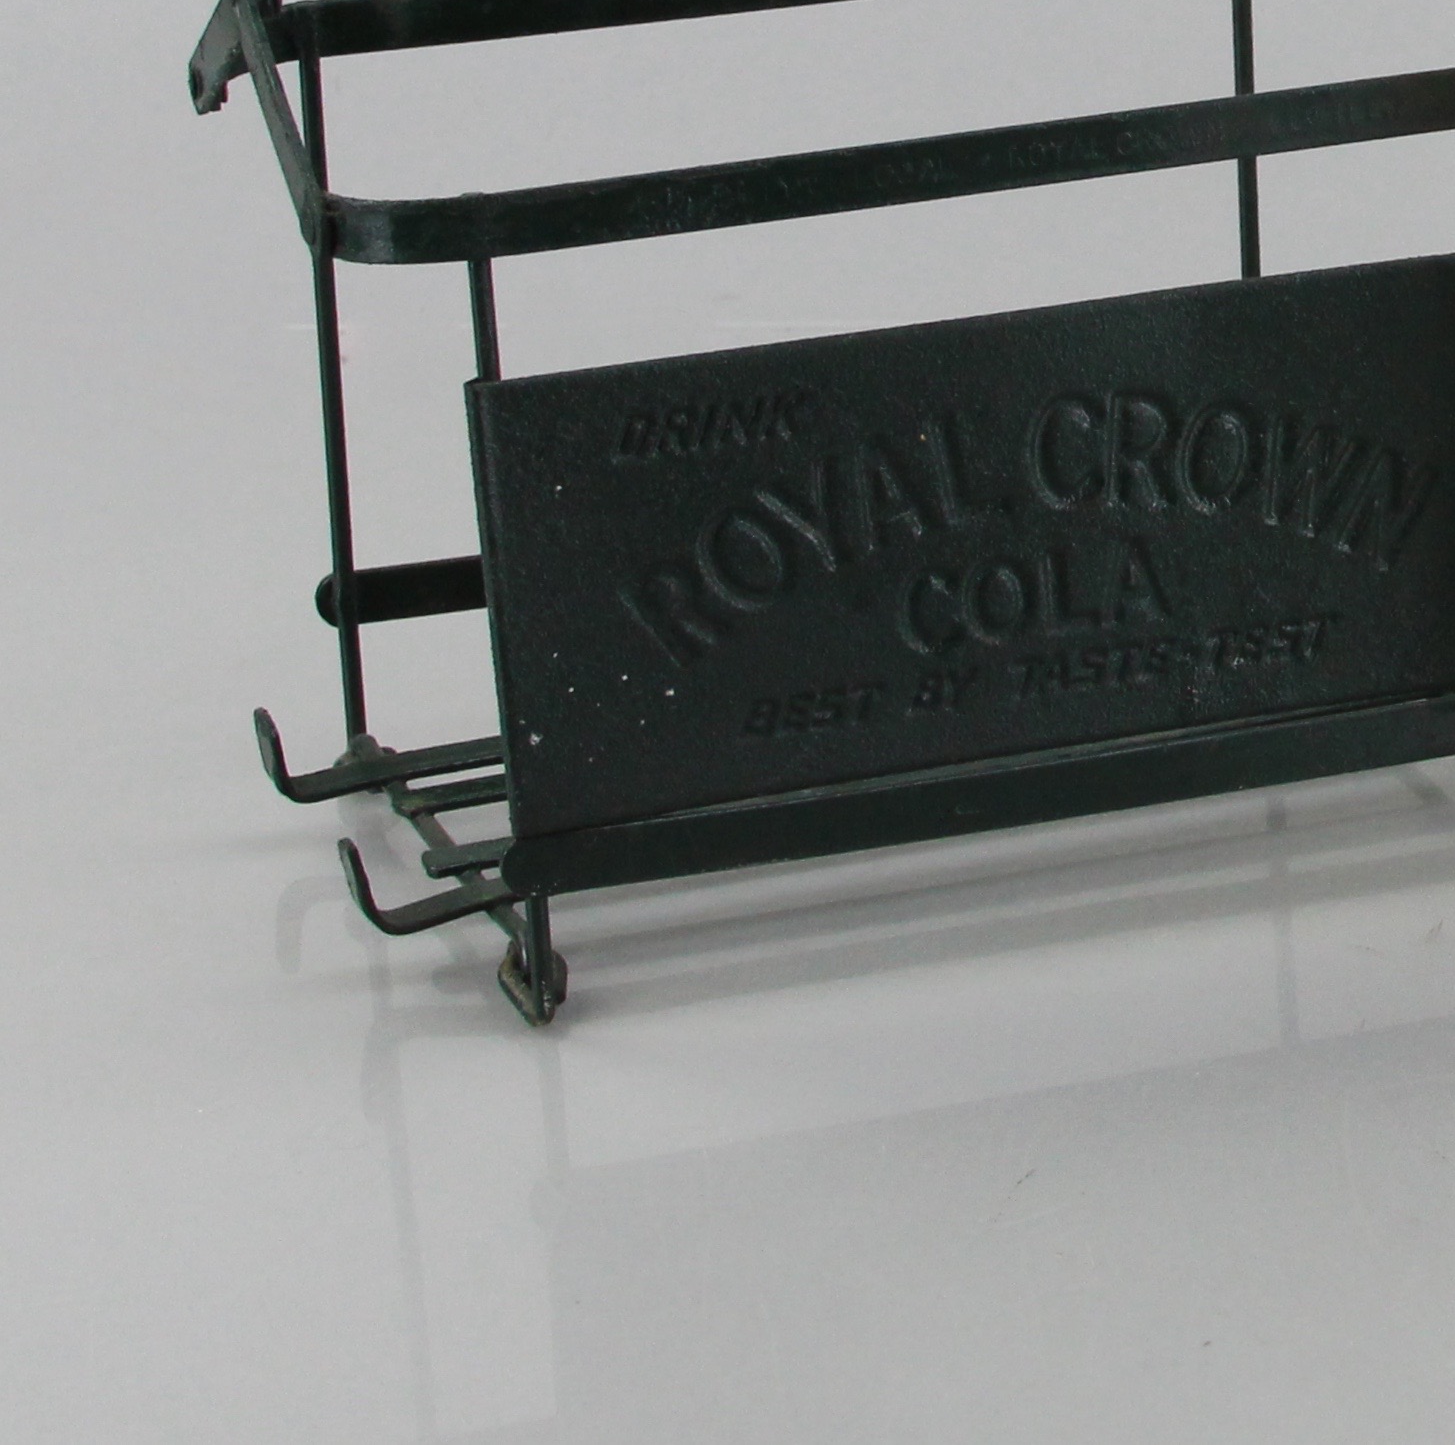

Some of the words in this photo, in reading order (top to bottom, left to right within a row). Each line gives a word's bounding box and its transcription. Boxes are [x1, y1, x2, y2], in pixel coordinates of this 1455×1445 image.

[614, 389, 814, 462] DRINK
[621, 416, 1009, 669] ROYAL
[1028, 389, 1441, 573] CROWN
[899, 537, 1173, 658] COLA
